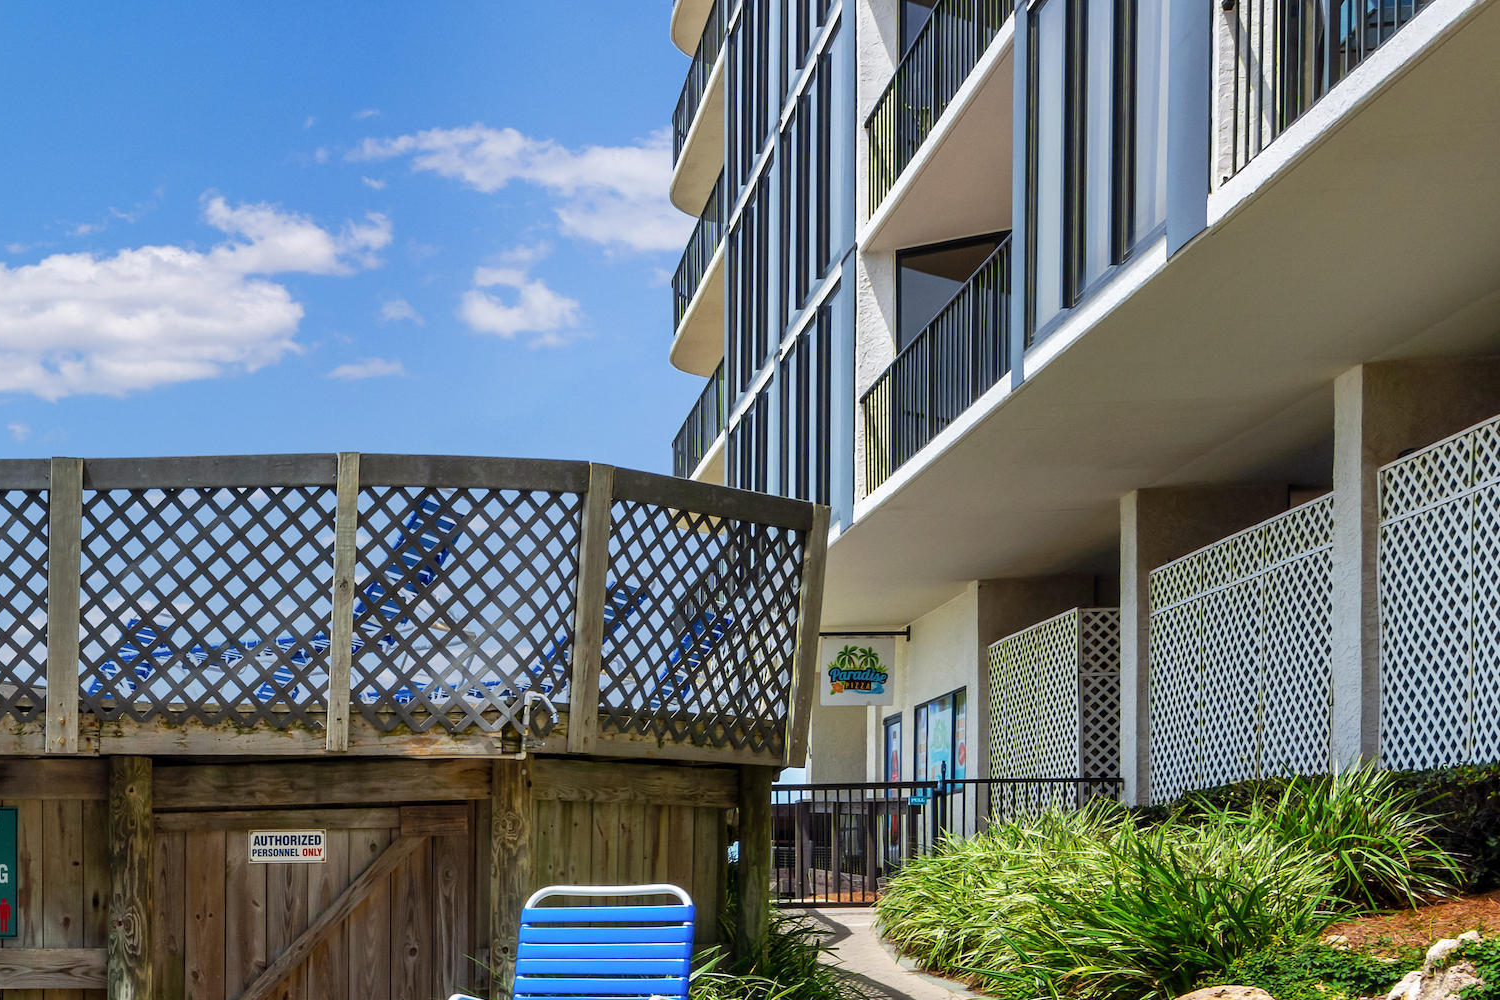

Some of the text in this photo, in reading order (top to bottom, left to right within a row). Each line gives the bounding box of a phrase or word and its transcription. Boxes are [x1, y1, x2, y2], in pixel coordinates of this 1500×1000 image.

[829, 667, 888, 684] Paradise
[845, 681, 871, 690] PIZZA
[253, 835, 322, 846] AUTHORIZED
[252, 848, 323, 857] PERSONNEL ONLY
